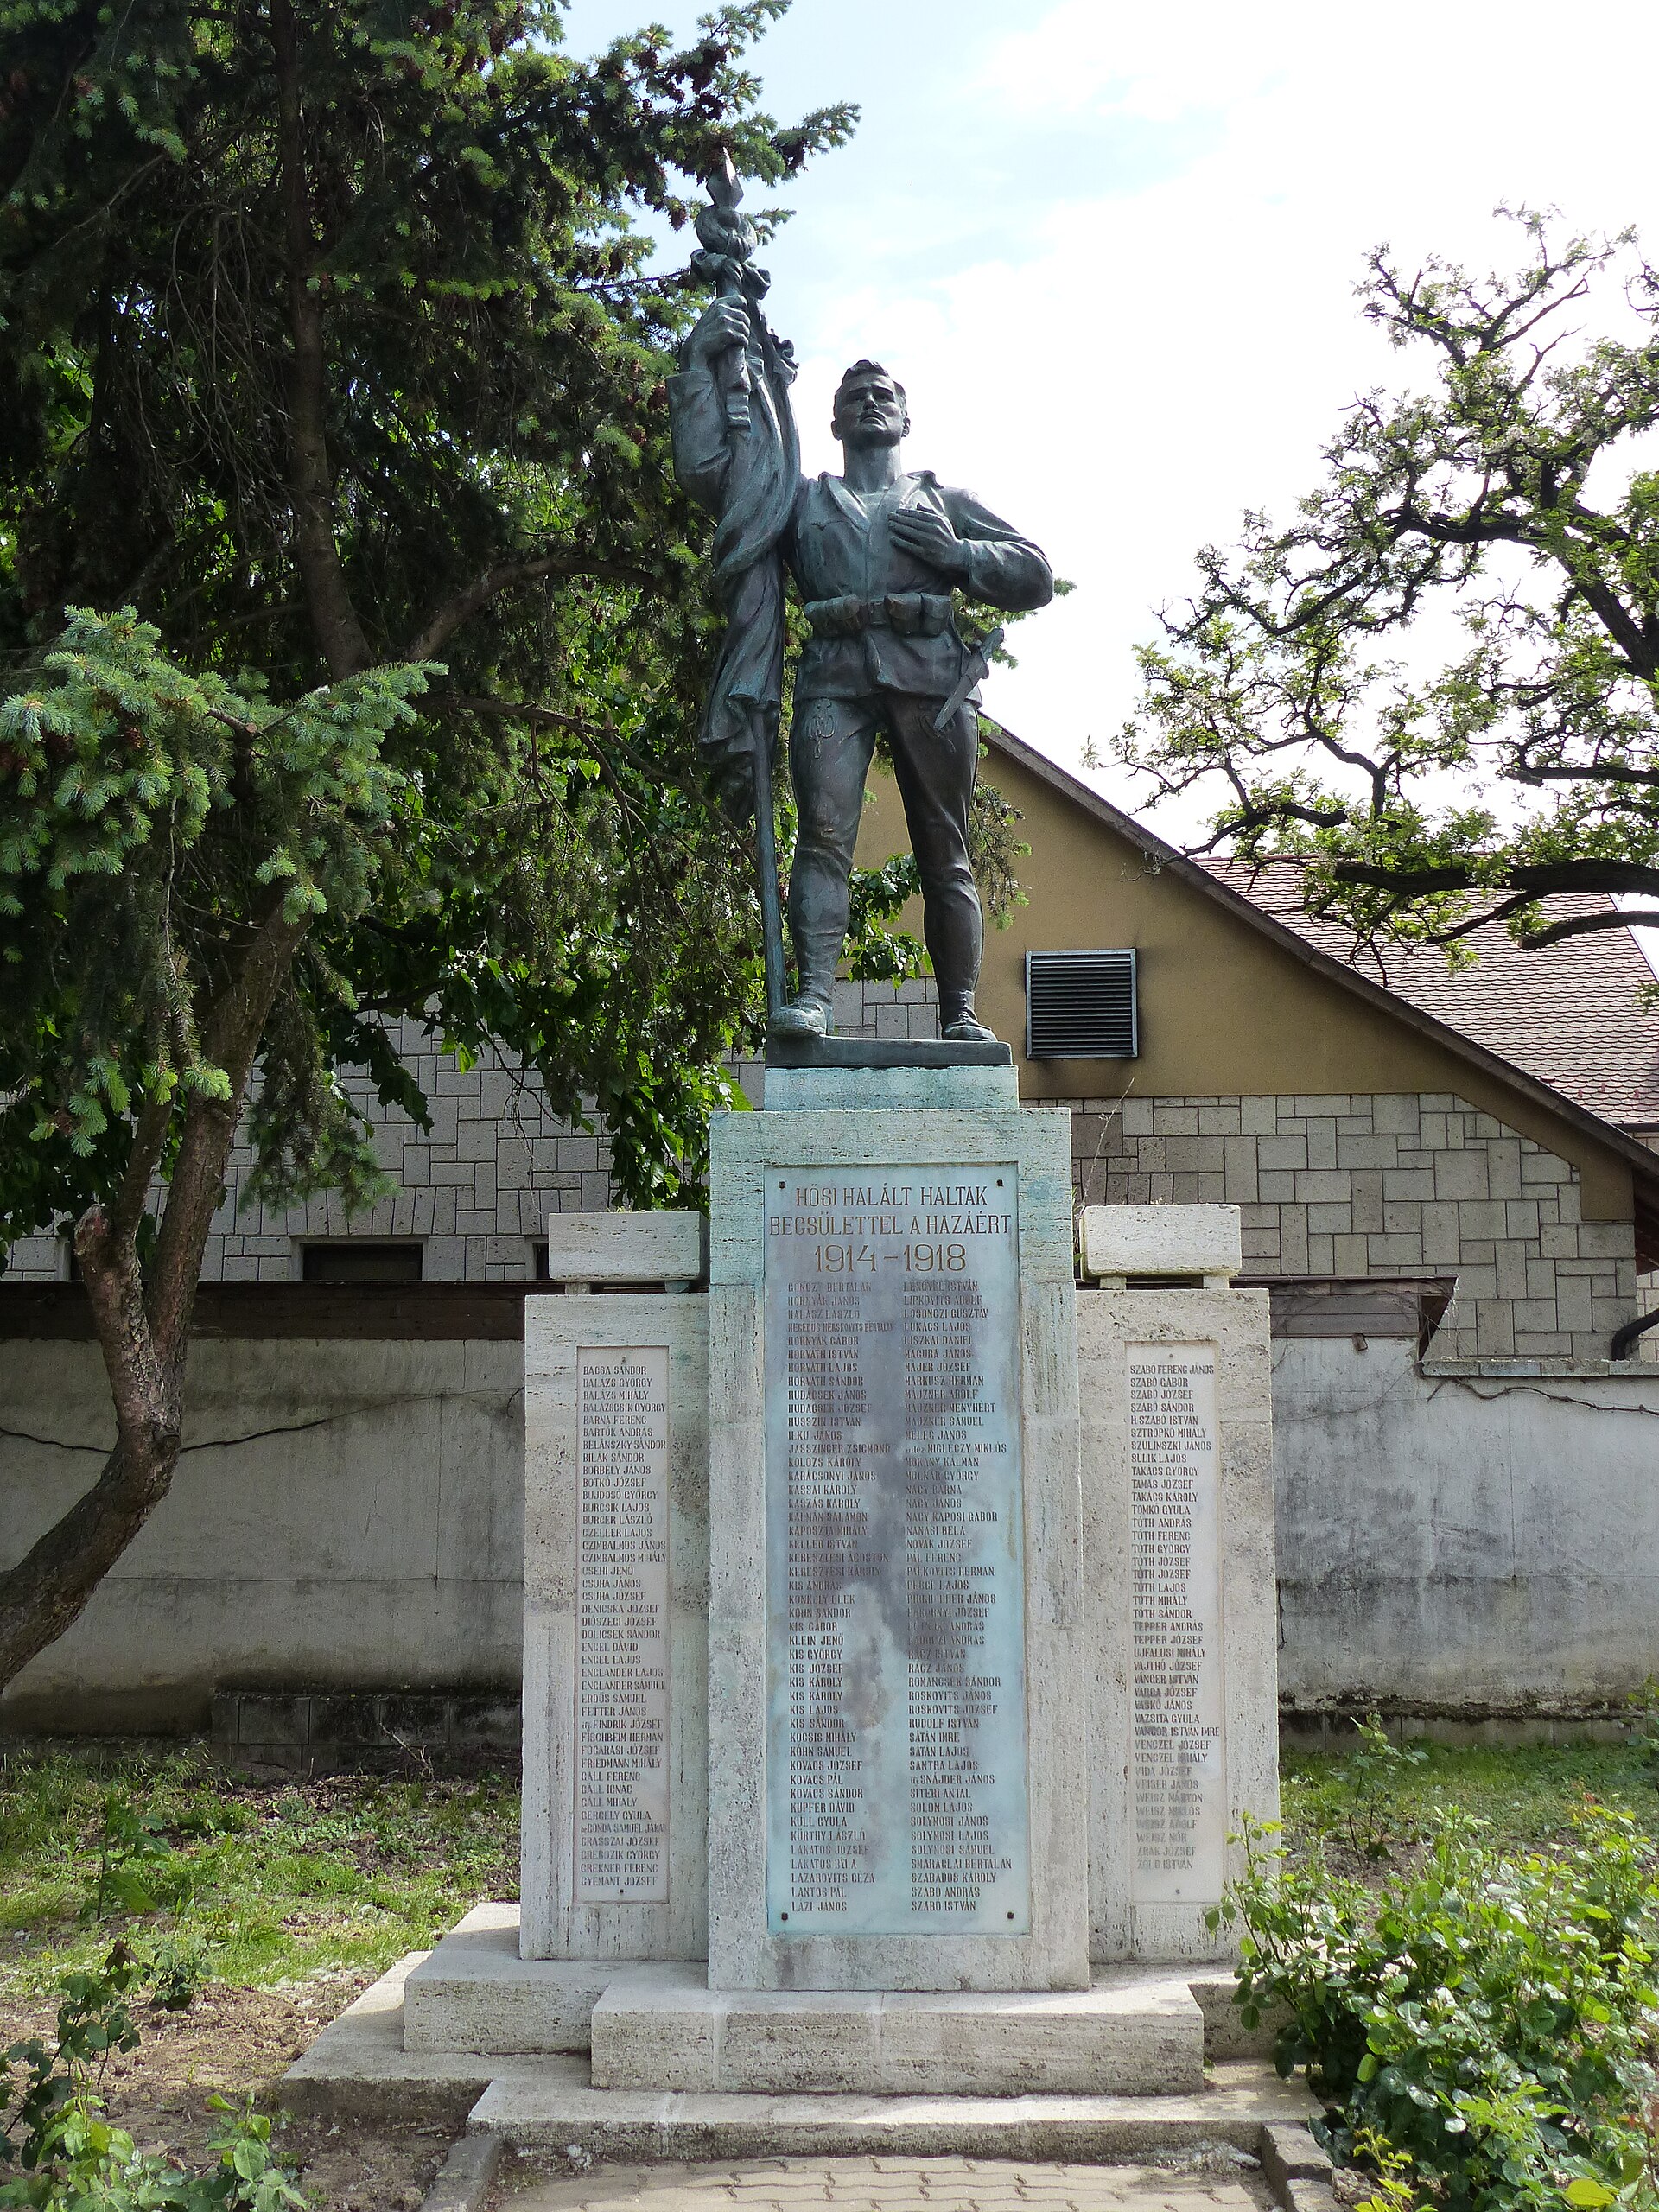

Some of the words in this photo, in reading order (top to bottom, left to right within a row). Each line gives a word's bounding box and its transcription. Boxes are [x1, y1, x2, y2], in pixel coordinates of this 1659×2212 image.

[795, 1184, 837, 1207] HŐSI
[843, 1183, 912, 1206] HALÁLT
[920, 1186, 988, 1205] HALTAK
[910, 1216, 921, 1235] A
[926, 1211, 1012, 1235] HAZÁÉRT
